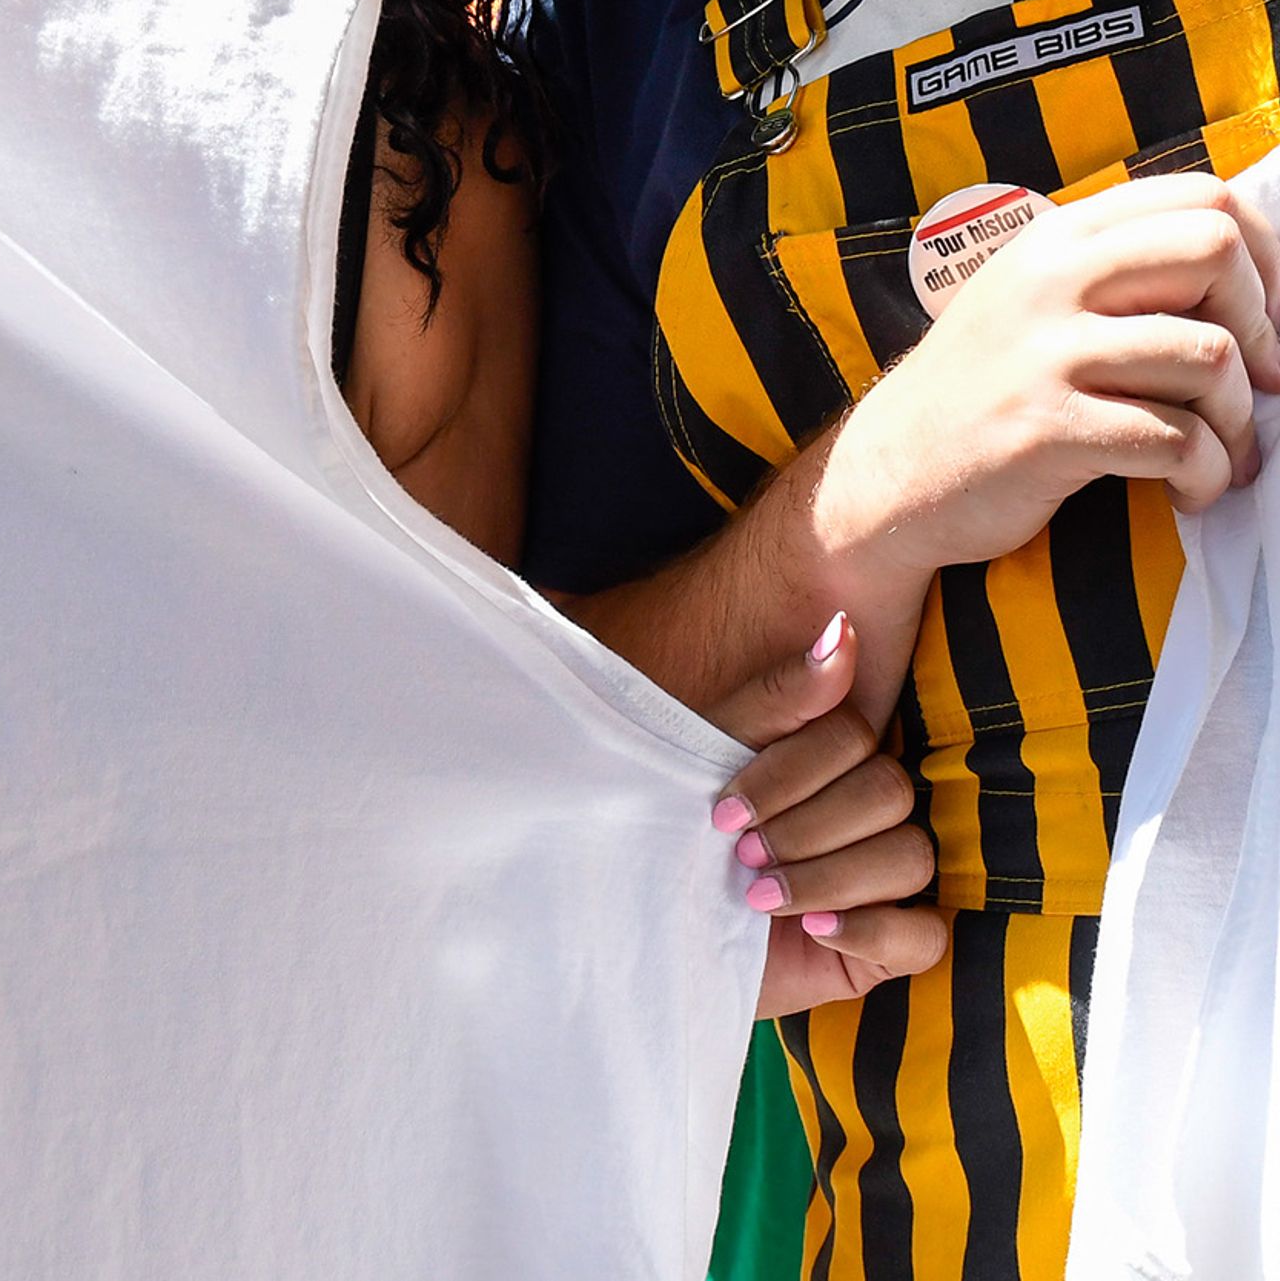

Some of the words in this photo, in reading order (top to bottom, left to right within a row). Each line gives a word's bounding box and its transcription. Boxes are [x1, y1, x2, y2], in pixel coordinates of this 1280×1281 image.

[917, 45, 1019, 96] GAME
[1033, 13, 1135, 60] BIBS
[922, 231, 967, 258] "Our
[965, 202, 1036, 244] history
[923, 265, 957, 293] did
